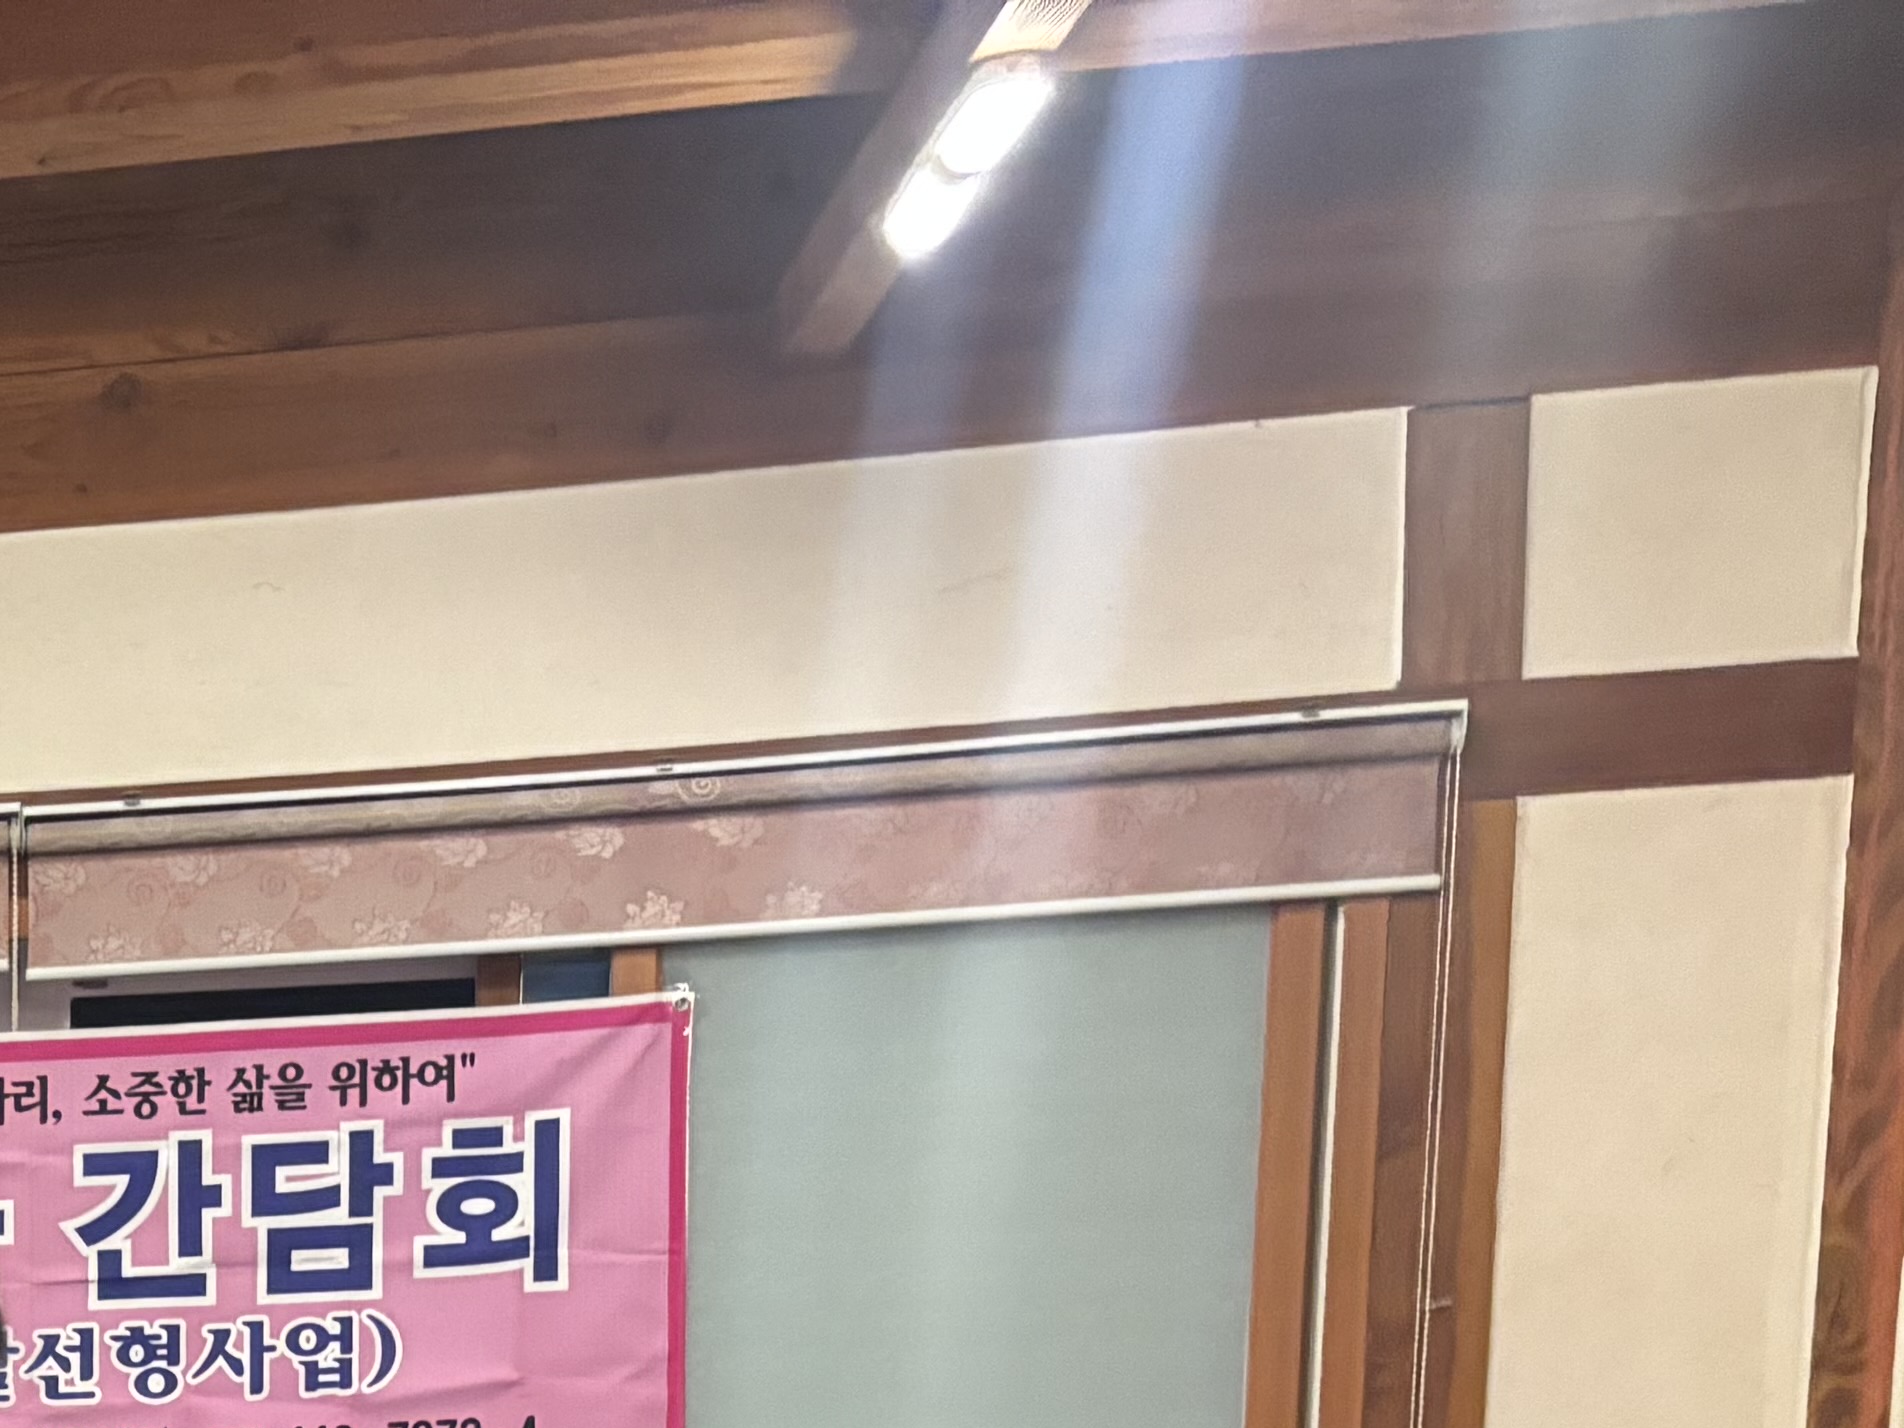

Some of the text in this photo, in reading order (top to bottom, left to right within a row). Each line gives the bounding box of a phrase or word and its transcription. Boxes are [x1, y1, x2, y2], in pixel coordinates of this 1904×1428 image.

[81, 1066, 212, 1120] 소중한
[225, 1061, 313, 1114] 삶을
[328, 1051, 477, 1107] 위하여"
[68, 1113, 566, 1305] 간담회
